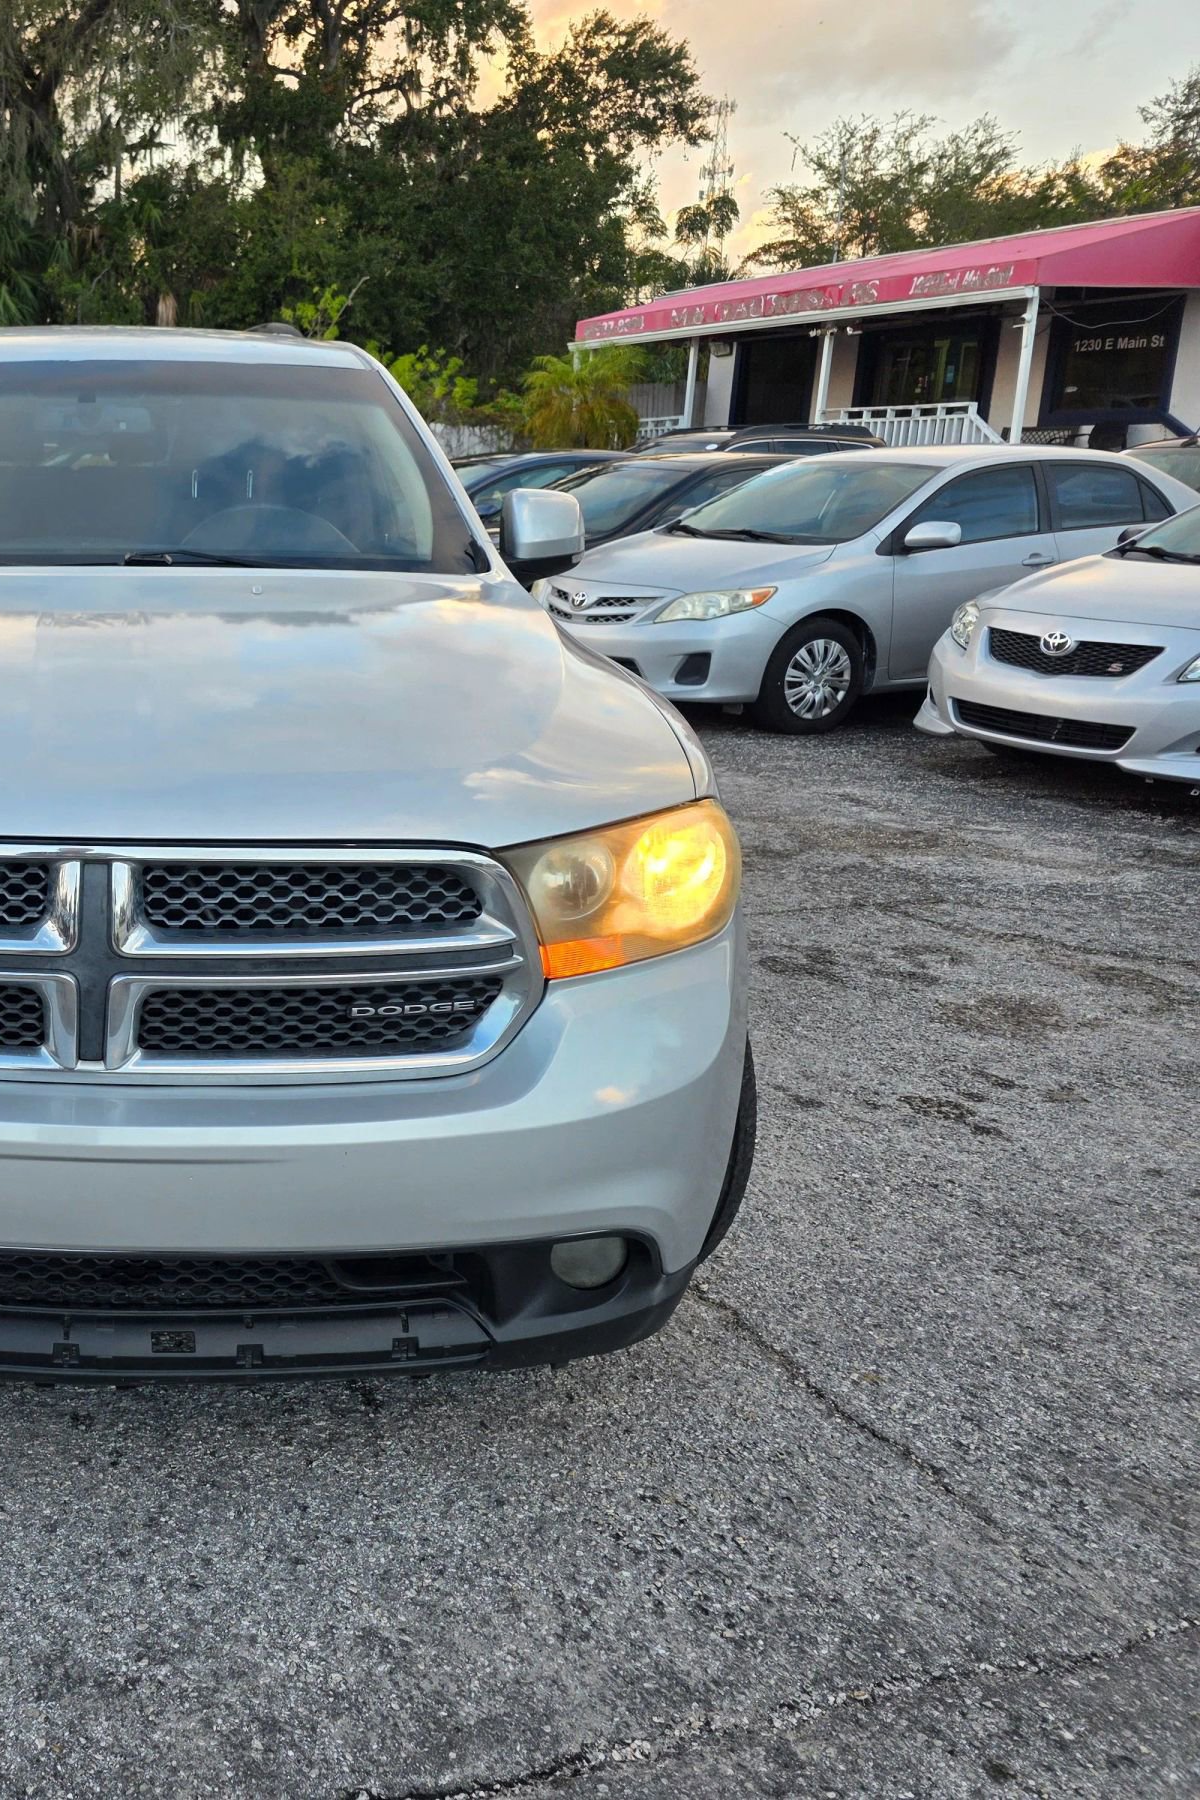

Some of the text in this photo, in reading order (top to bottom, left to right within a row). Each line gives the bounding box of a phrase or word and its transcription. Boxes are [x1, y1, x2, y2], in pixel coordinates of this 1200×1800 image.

[1074, 334, 1165, 352] 1230 E Main St
[351, 1000, 475, 1017] DODGE
